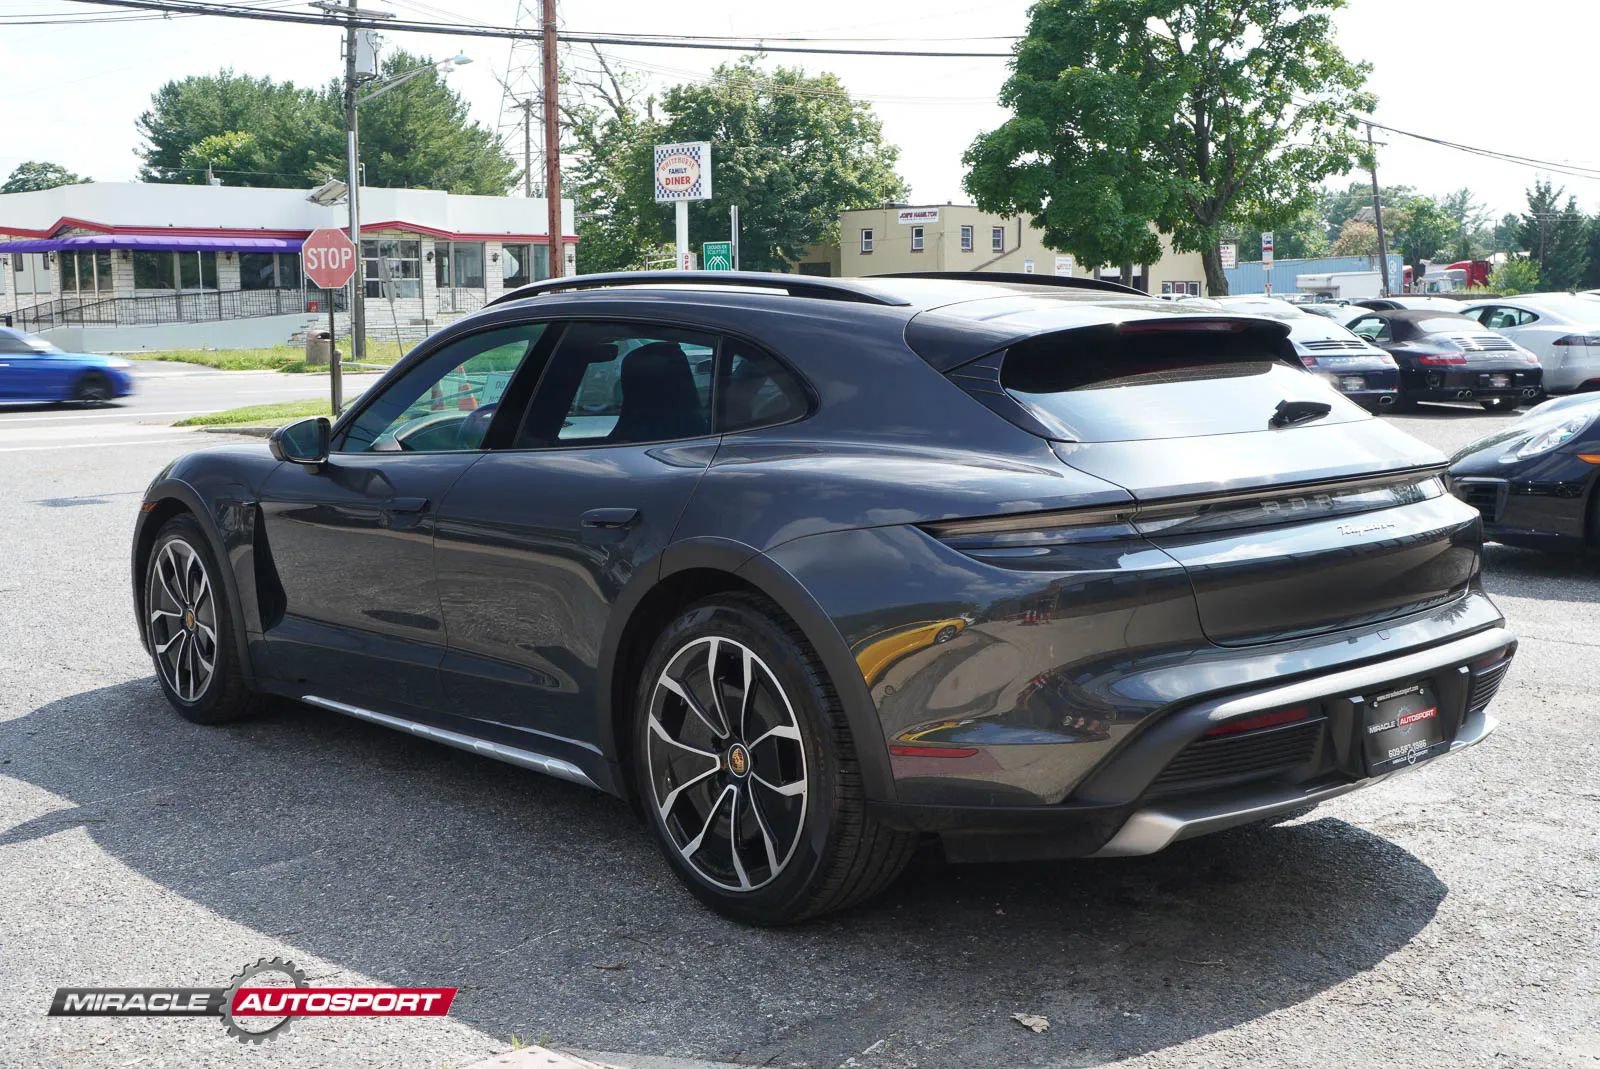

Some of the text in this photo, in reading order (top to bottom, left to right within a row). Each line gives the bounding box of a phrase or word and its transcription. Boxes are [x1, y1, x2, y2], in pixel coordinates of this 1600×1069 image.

[668, 167, 687, 175] FAMILY
[665, 176, 691, 186] DINER
[307, 247, 352, 270] STOP
[1369, 709, 1434, 734] MIRACLE AUTOSPORT
